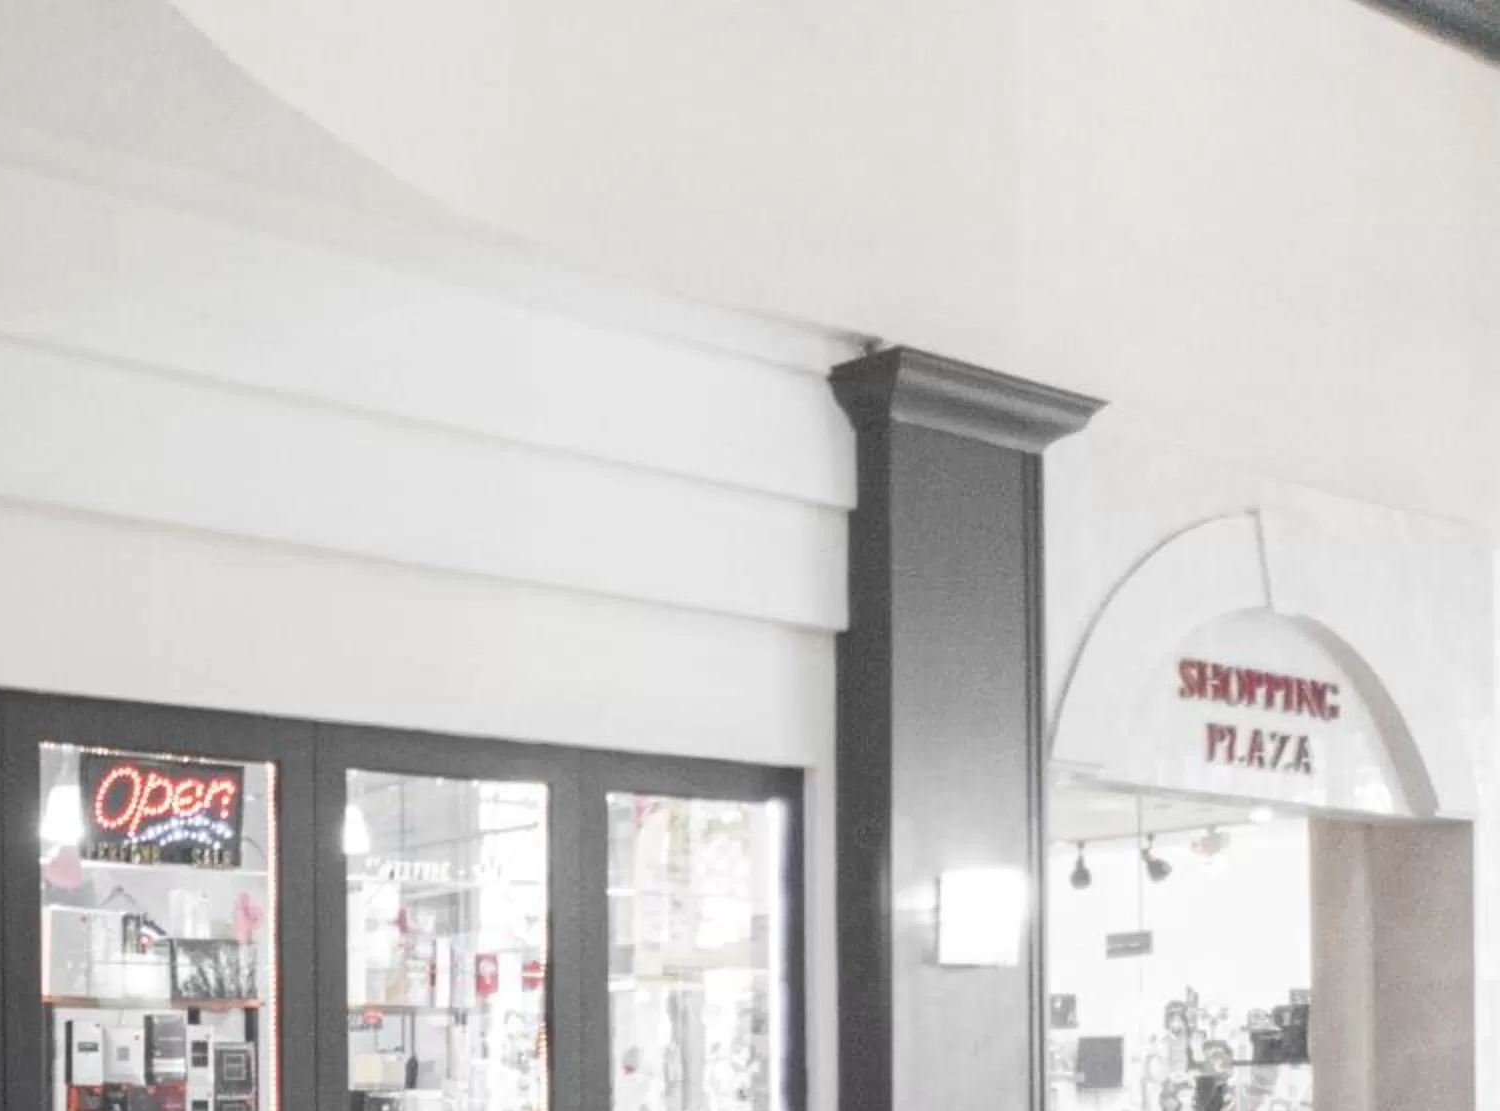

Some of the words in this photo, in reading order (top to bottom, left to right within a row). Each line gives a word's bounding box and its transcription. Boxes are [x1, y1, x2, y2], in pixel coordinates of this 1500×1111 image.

[1178, 657, 1340, 721] SHOPPING
[1205, 722, 1312, 774] PLAZA
[95, 764, 236, 838] Open
